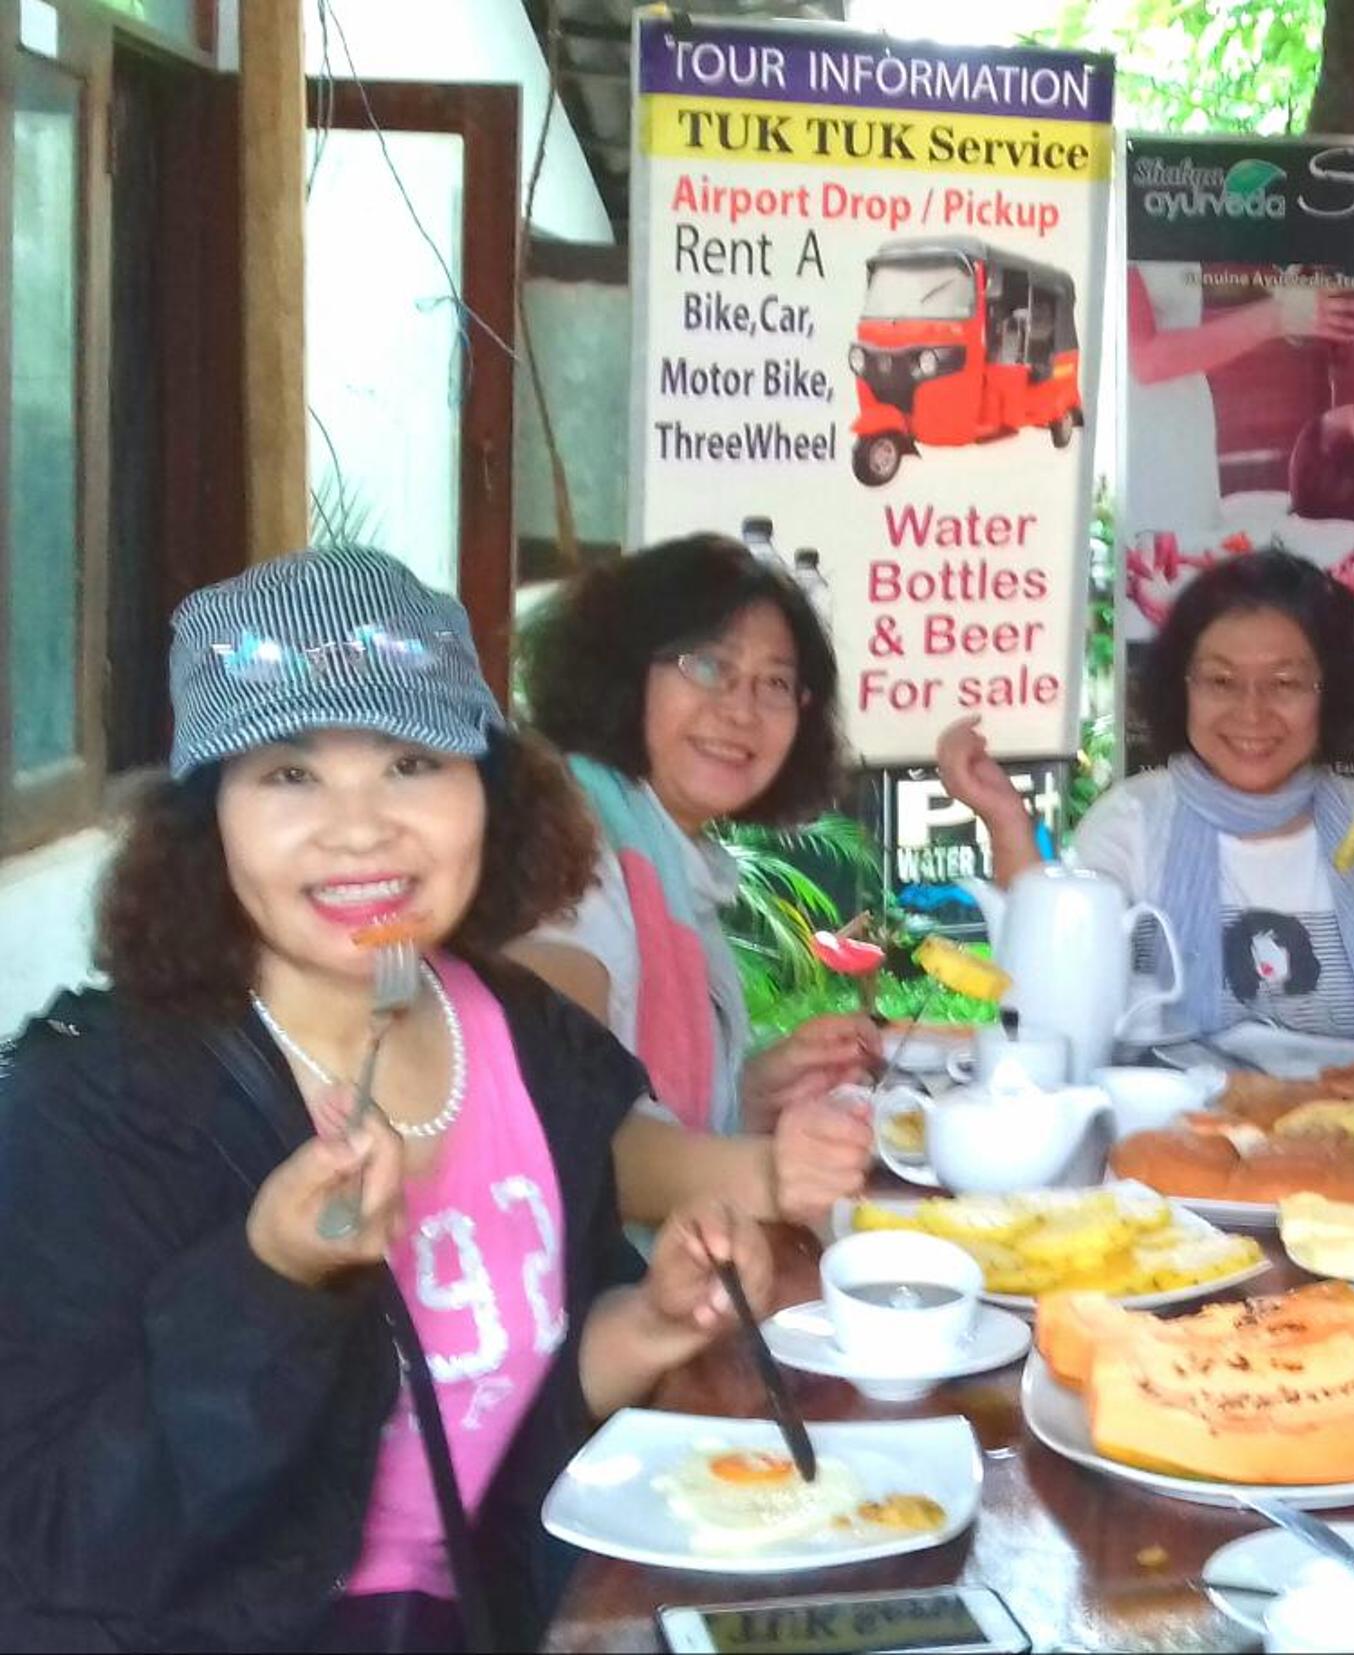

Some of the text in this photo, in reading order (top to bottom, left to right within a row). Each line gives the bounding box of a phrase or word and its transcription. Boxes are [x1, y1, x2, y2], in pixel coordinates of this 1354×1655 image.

[678, 109, 1090, 171] TUK TUK Service
[671, 174, 810, 224] Airport
[821, 182, 911, 231] Drop
[943, 190, 1061, 236] Pickup
[675, 223, 826, 278] Rent A
[660, 357, 834, 402] Motor Bike,
[654, 420, 837, 462] ThreeWheel
[884, 503, 1038, 548] Water
[867, 557, 1049, 604] Bottles
[868, 612, 1045, 657] & Beer
[858, 663, 1060, 713] For sale
